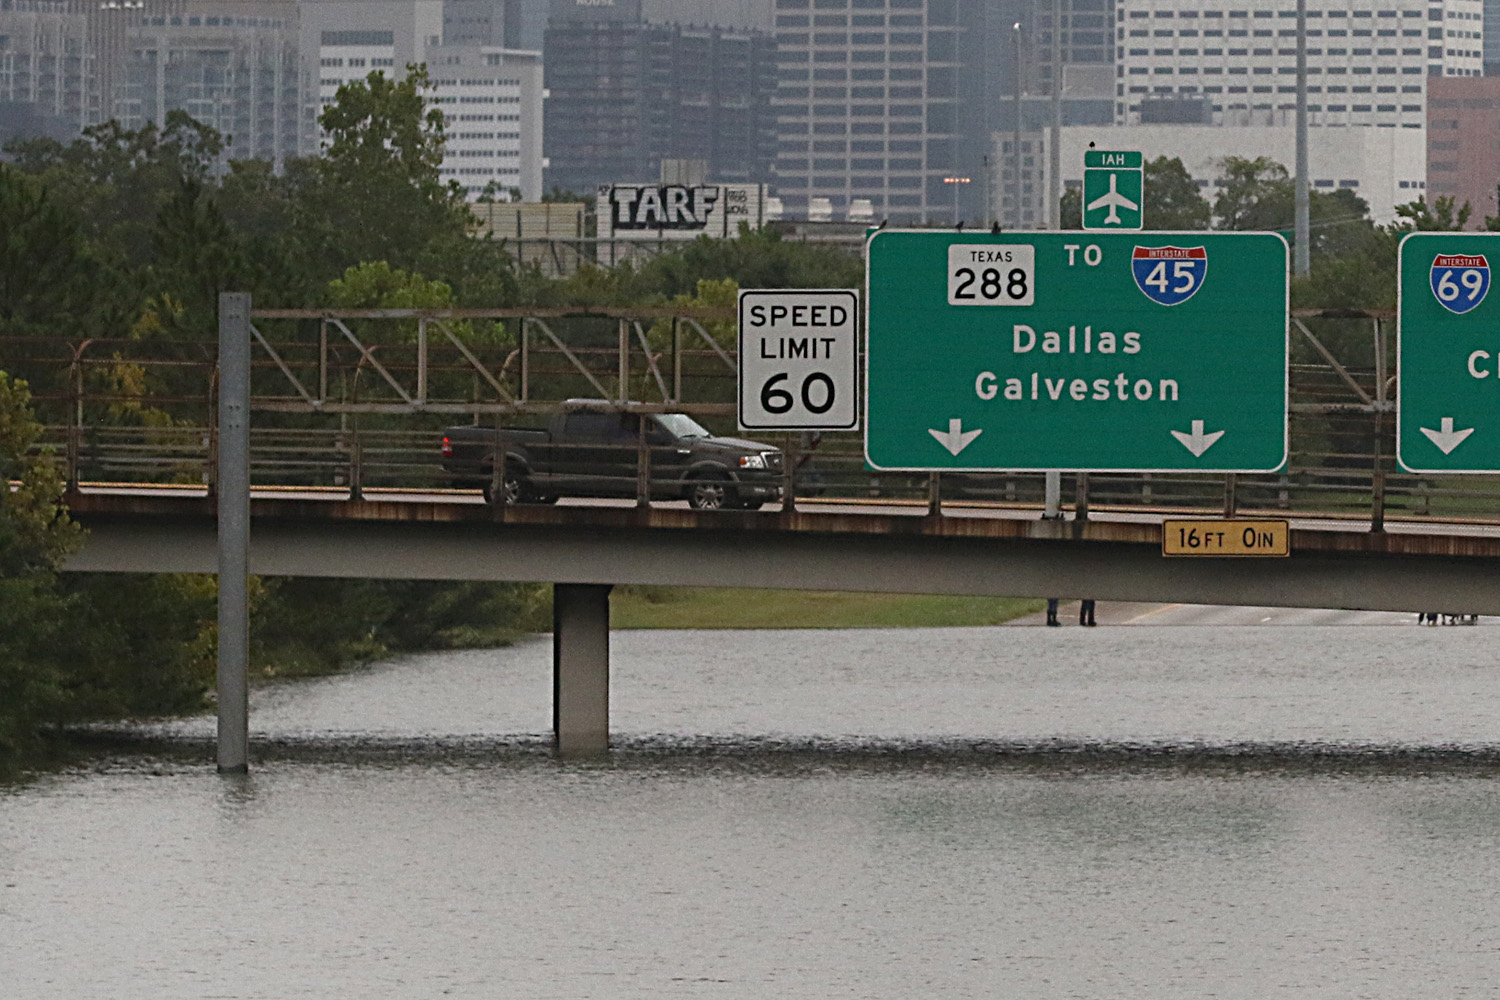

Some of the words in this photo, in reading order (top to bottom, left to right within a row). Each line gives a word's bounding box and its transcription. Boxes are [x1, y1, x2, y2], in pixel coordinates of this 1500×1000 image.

[1102, 154, 1125, 166] IAH
[611, 186, 719, 226] TARF
[971, 251, 1013, 263] TEXAS
[1064, 245, 1103, 266] TO
[1149, 250, 1191, 259] INTERSTATE
[1439, 257, 1481, 267] INTERSTATE
[954, 268, 1028, 300] 288
[1145, 261, 1196, 294] 45
[1437, 269, 1484, 301] 69
[750, 305, 848, 327] SPEED
[760, 338, 836, 359] LIMIT
[1013, 324, 1142, 354] Dallas
[760, 372, 836, 414] 60
[975, 371, 1179, 401] Galveston
